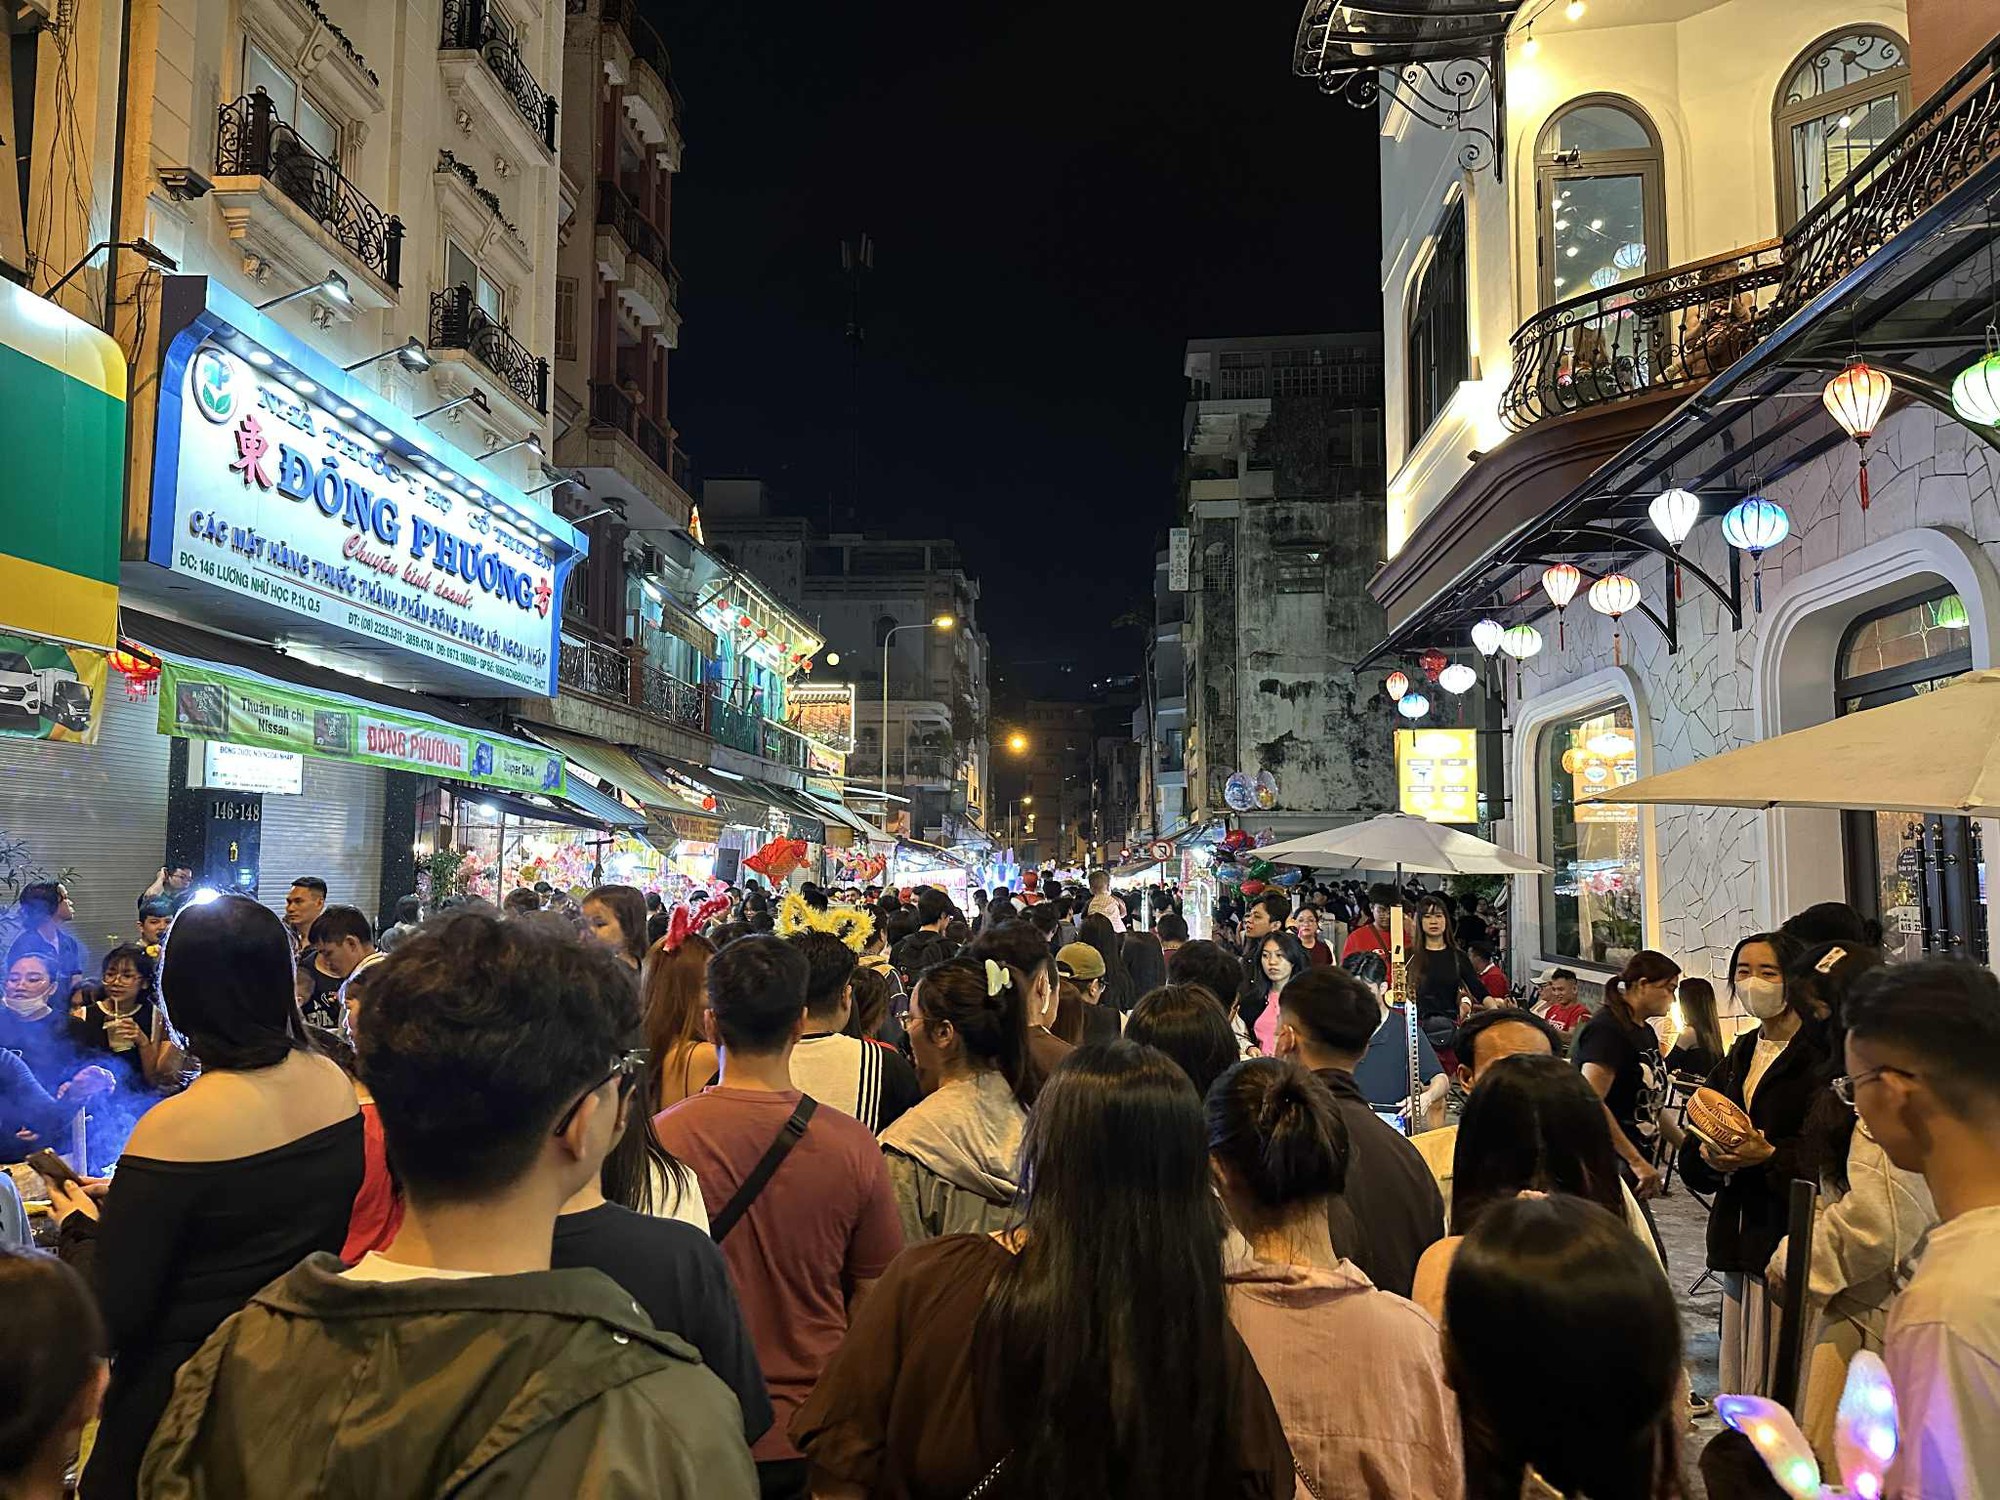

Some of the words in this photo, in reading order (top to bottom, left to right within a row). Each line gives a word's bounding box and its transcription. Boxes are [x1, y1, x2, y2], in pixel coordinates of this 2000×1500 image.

[229, 414, 273, 491] 東
[257, 385, 316, 437] NHÀ
[323, 427, 400, 483] THUỐC
[277, 443, 401, 548] ĐÔNG
[410, 514, 535, 612] PHƯƠNG
[180, 551, 197, 571] ĐC:
[199, 558, 215, 576] 146
[217, 564, 249, 587] LƯƠNG
[271, 584, 289, 603] HỌC
[307, 598, 321, 613] Q.5
[189, 510, 229, 548] CÁC
[231, 526, 266, 560] MẶT
[267, 540, 309, 579] HÀNG
[311, 558, 357, 596] THUỐC
[358, 578, 398, 610] THÀNH
[342, 533, 398, 577] Chuyên
[401, 562, 431, 593] kinh
[348, 612, 360, 627] ĐT:
[258, 718, 289, 736] Nissan
[272, 704, 289, 719] linh
[291, 708, 305, 722] chi
[366, 722, 406, 757] ĐÔNG
[409, 734, 461, 767] PHƯƠNG
[503, 760, 521, 776] Super
[521, 764, 534, 777] DHA
